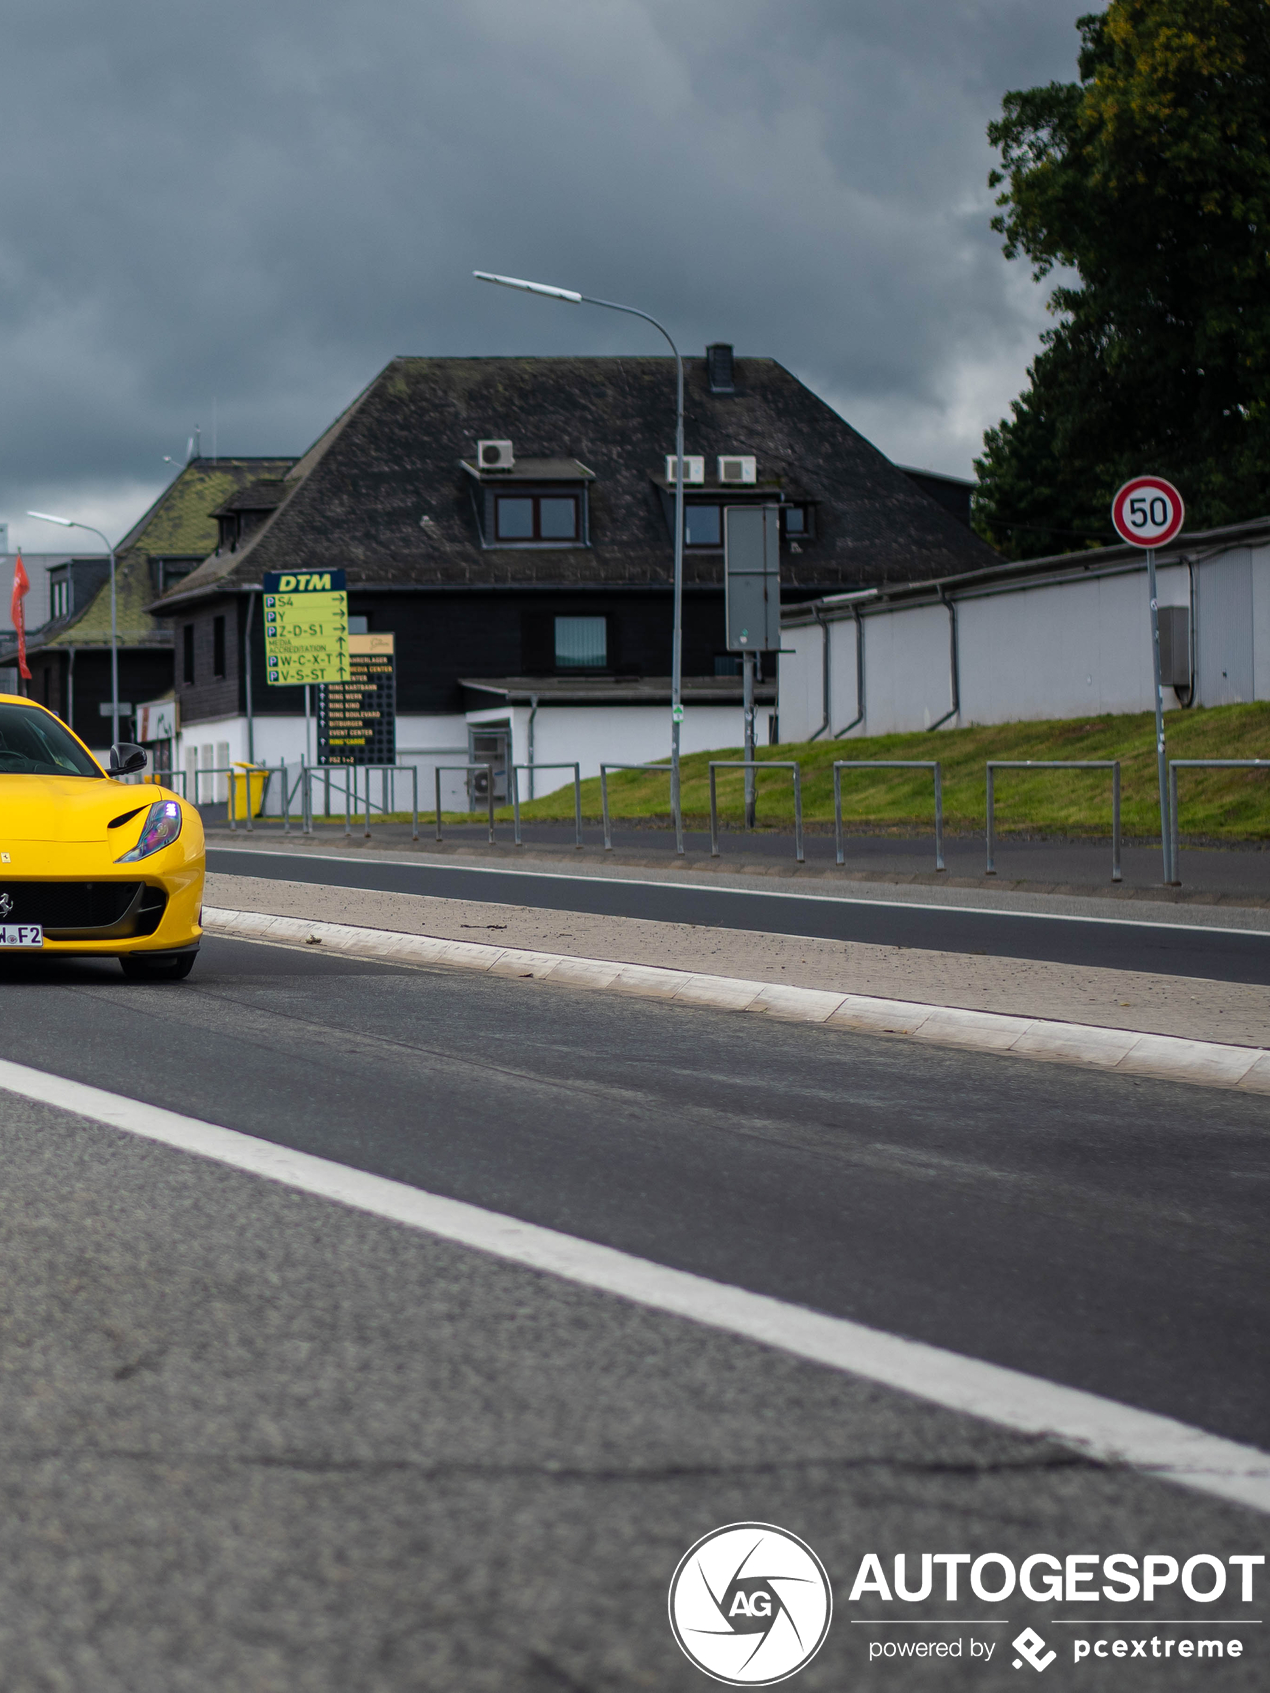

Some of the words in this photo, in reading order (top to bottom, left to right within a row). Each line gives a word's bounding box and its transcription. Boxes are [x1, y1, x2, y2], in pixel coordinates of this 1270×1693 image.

[1130, 497, 1168, 528] 50
[279, 574, 331, 592] DTM
[267, 597, 274, 607] P
[278, 596, 294, 607] S4
[268, 612, 275, 621] P
[278, 611, 285, 622] Y
[268, 626, 275, 636] P
[279, 624, 323, 637] Z-D-S1
[269, 644, 326, 654] ACCREDITATION
[270, 657, 276, 666] P
[280, 654, 333, 666] W-C-X-T
[271, 671, 277, 681] P
[281, 669, 326, 682] V-S-ST
[18, 927, 41, 944] F2
